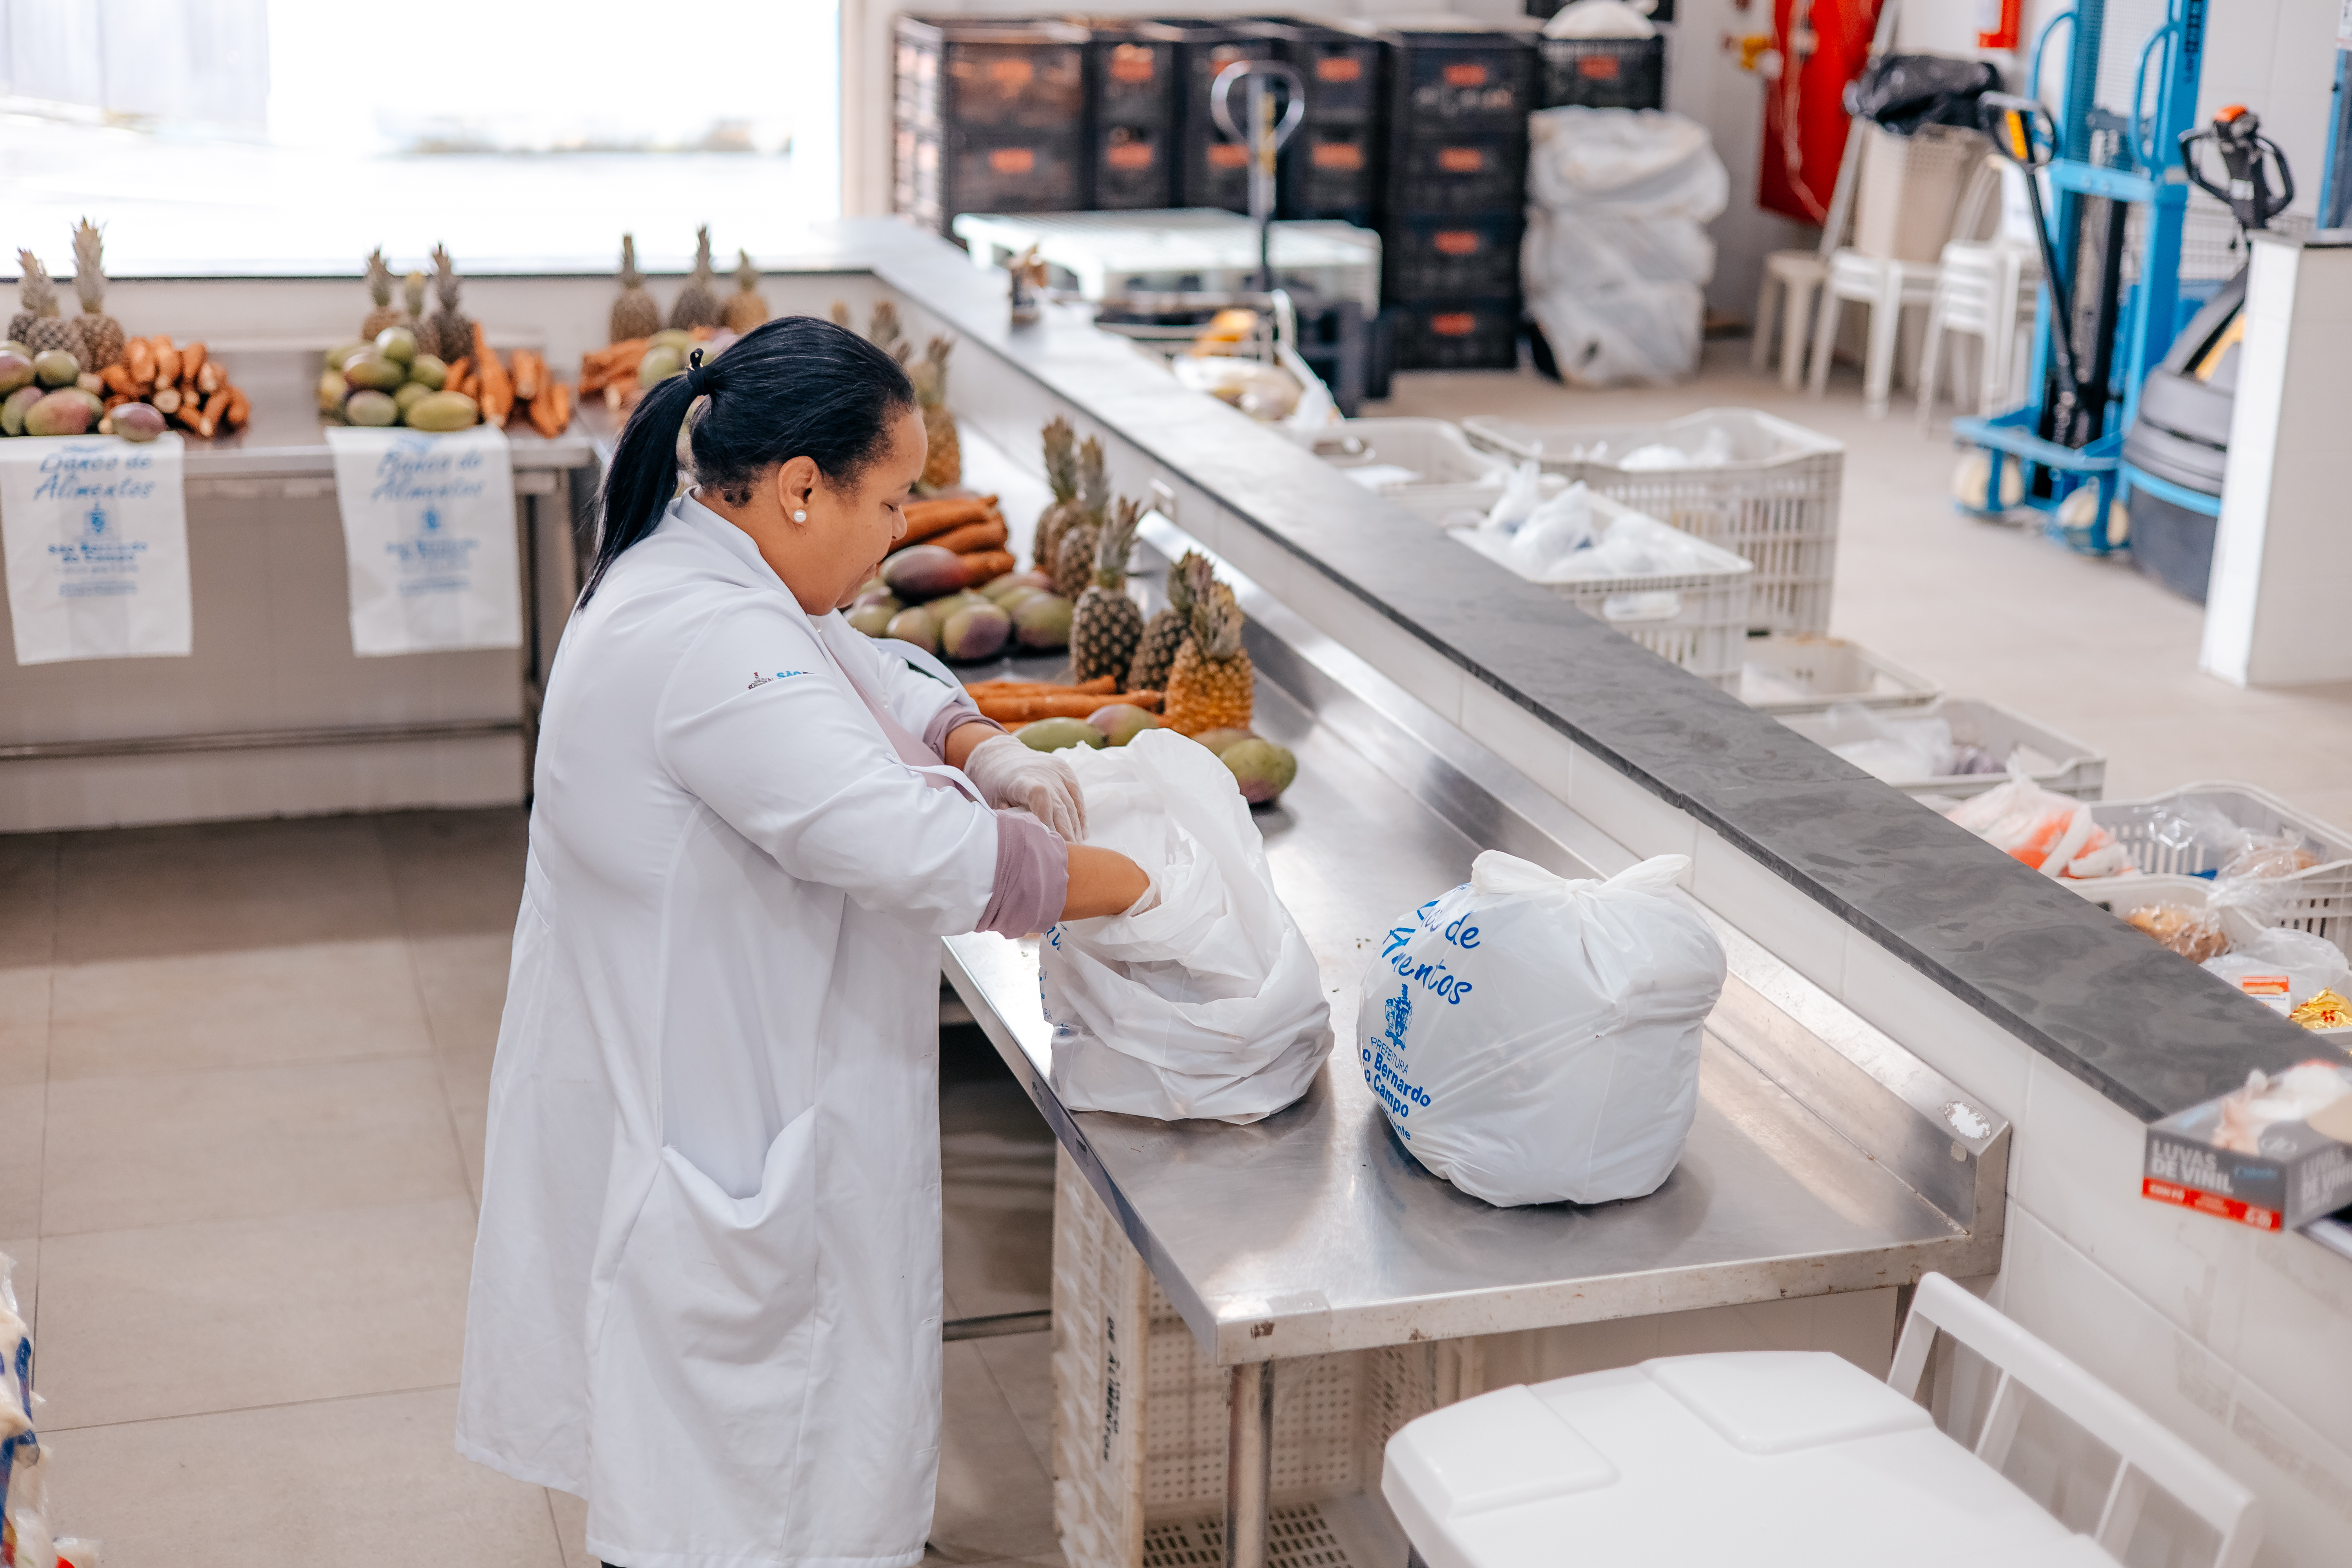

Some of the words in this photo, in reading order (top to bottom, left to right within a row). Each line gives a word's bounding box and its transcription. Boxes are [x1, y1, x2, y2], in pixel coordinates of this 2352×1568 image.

[33, 472, 155, 501] Alimentos
[1445, 910, 1480, 949] de
[1370, 1036, 1408, 1076] PREFEITURA
[1374, 1052, 1431, 1107] Bernardo
[1374, 1074, 1409, 1118] Campo
[2152, 1139, 2218, 1170] LUVAS
[2151, 1158, 2178, 1178] DE
[2180, 1163, 2234, 1195] VINIL
